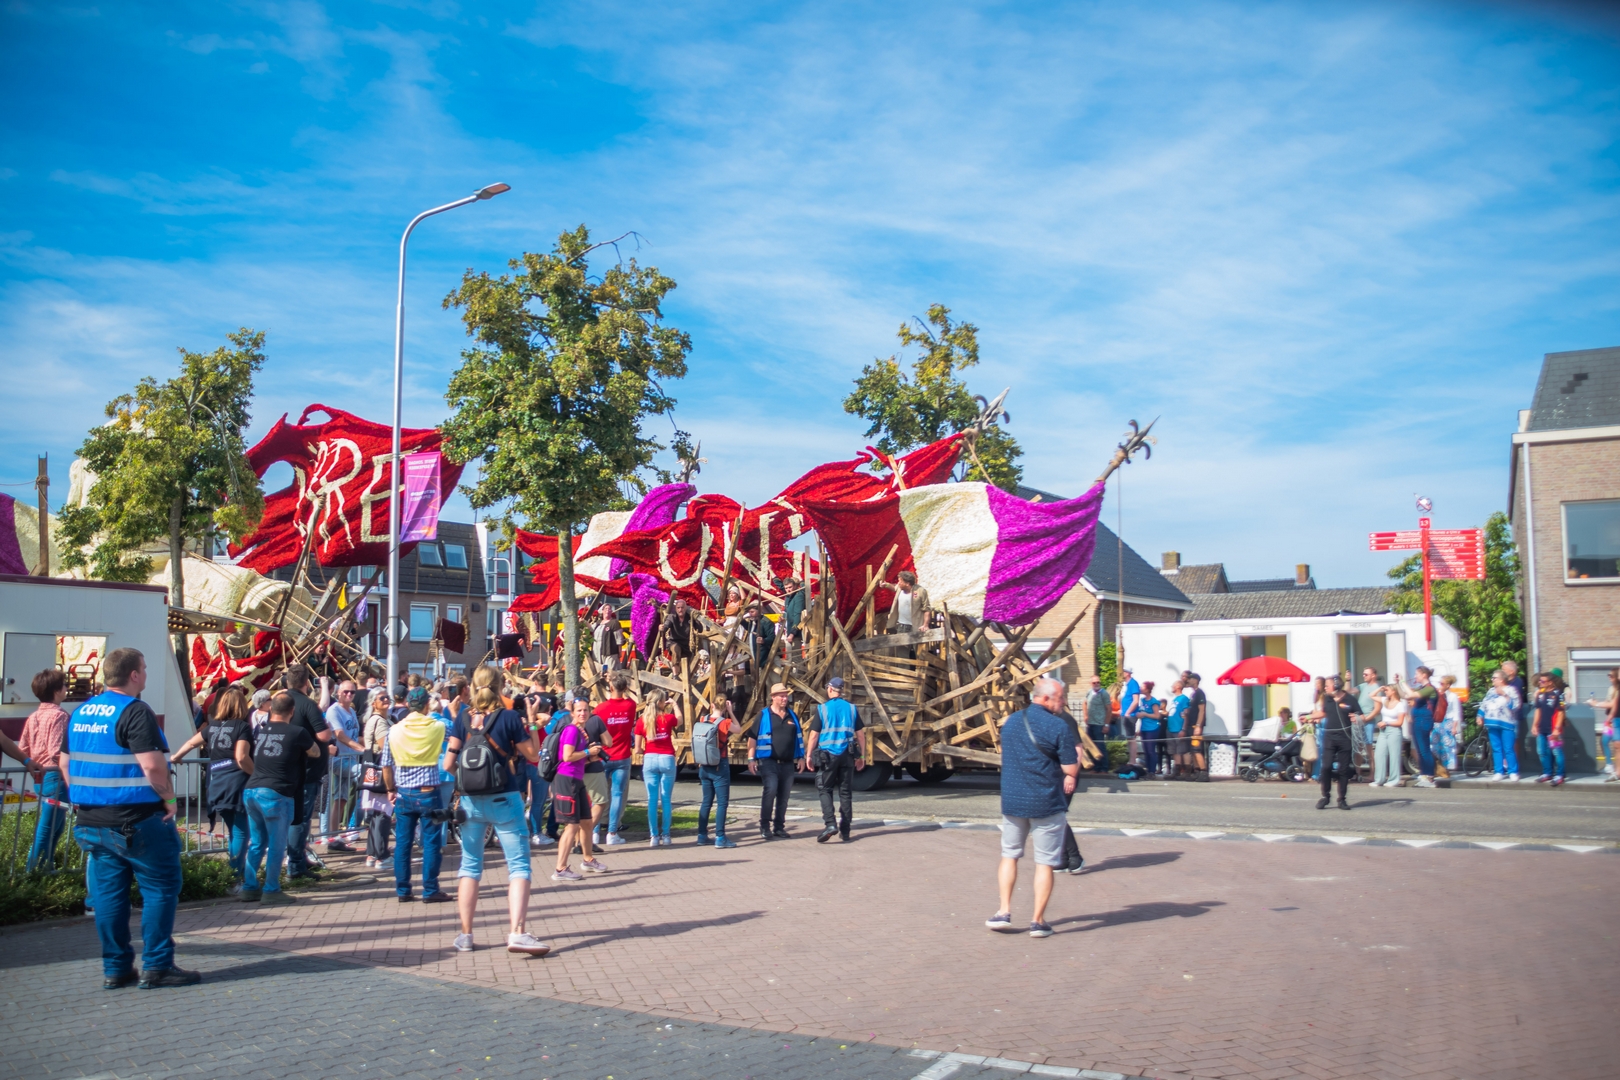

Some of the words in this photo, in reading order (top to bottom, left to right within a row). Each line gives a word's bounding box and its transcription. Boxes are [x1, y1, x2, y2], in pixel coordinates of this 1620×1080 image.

[80, 704, 116, 717] corso
[73, 722, 108, 734] zundert
[208, 726, 234, 749] 75
[254, 733, 286, 757] 75
